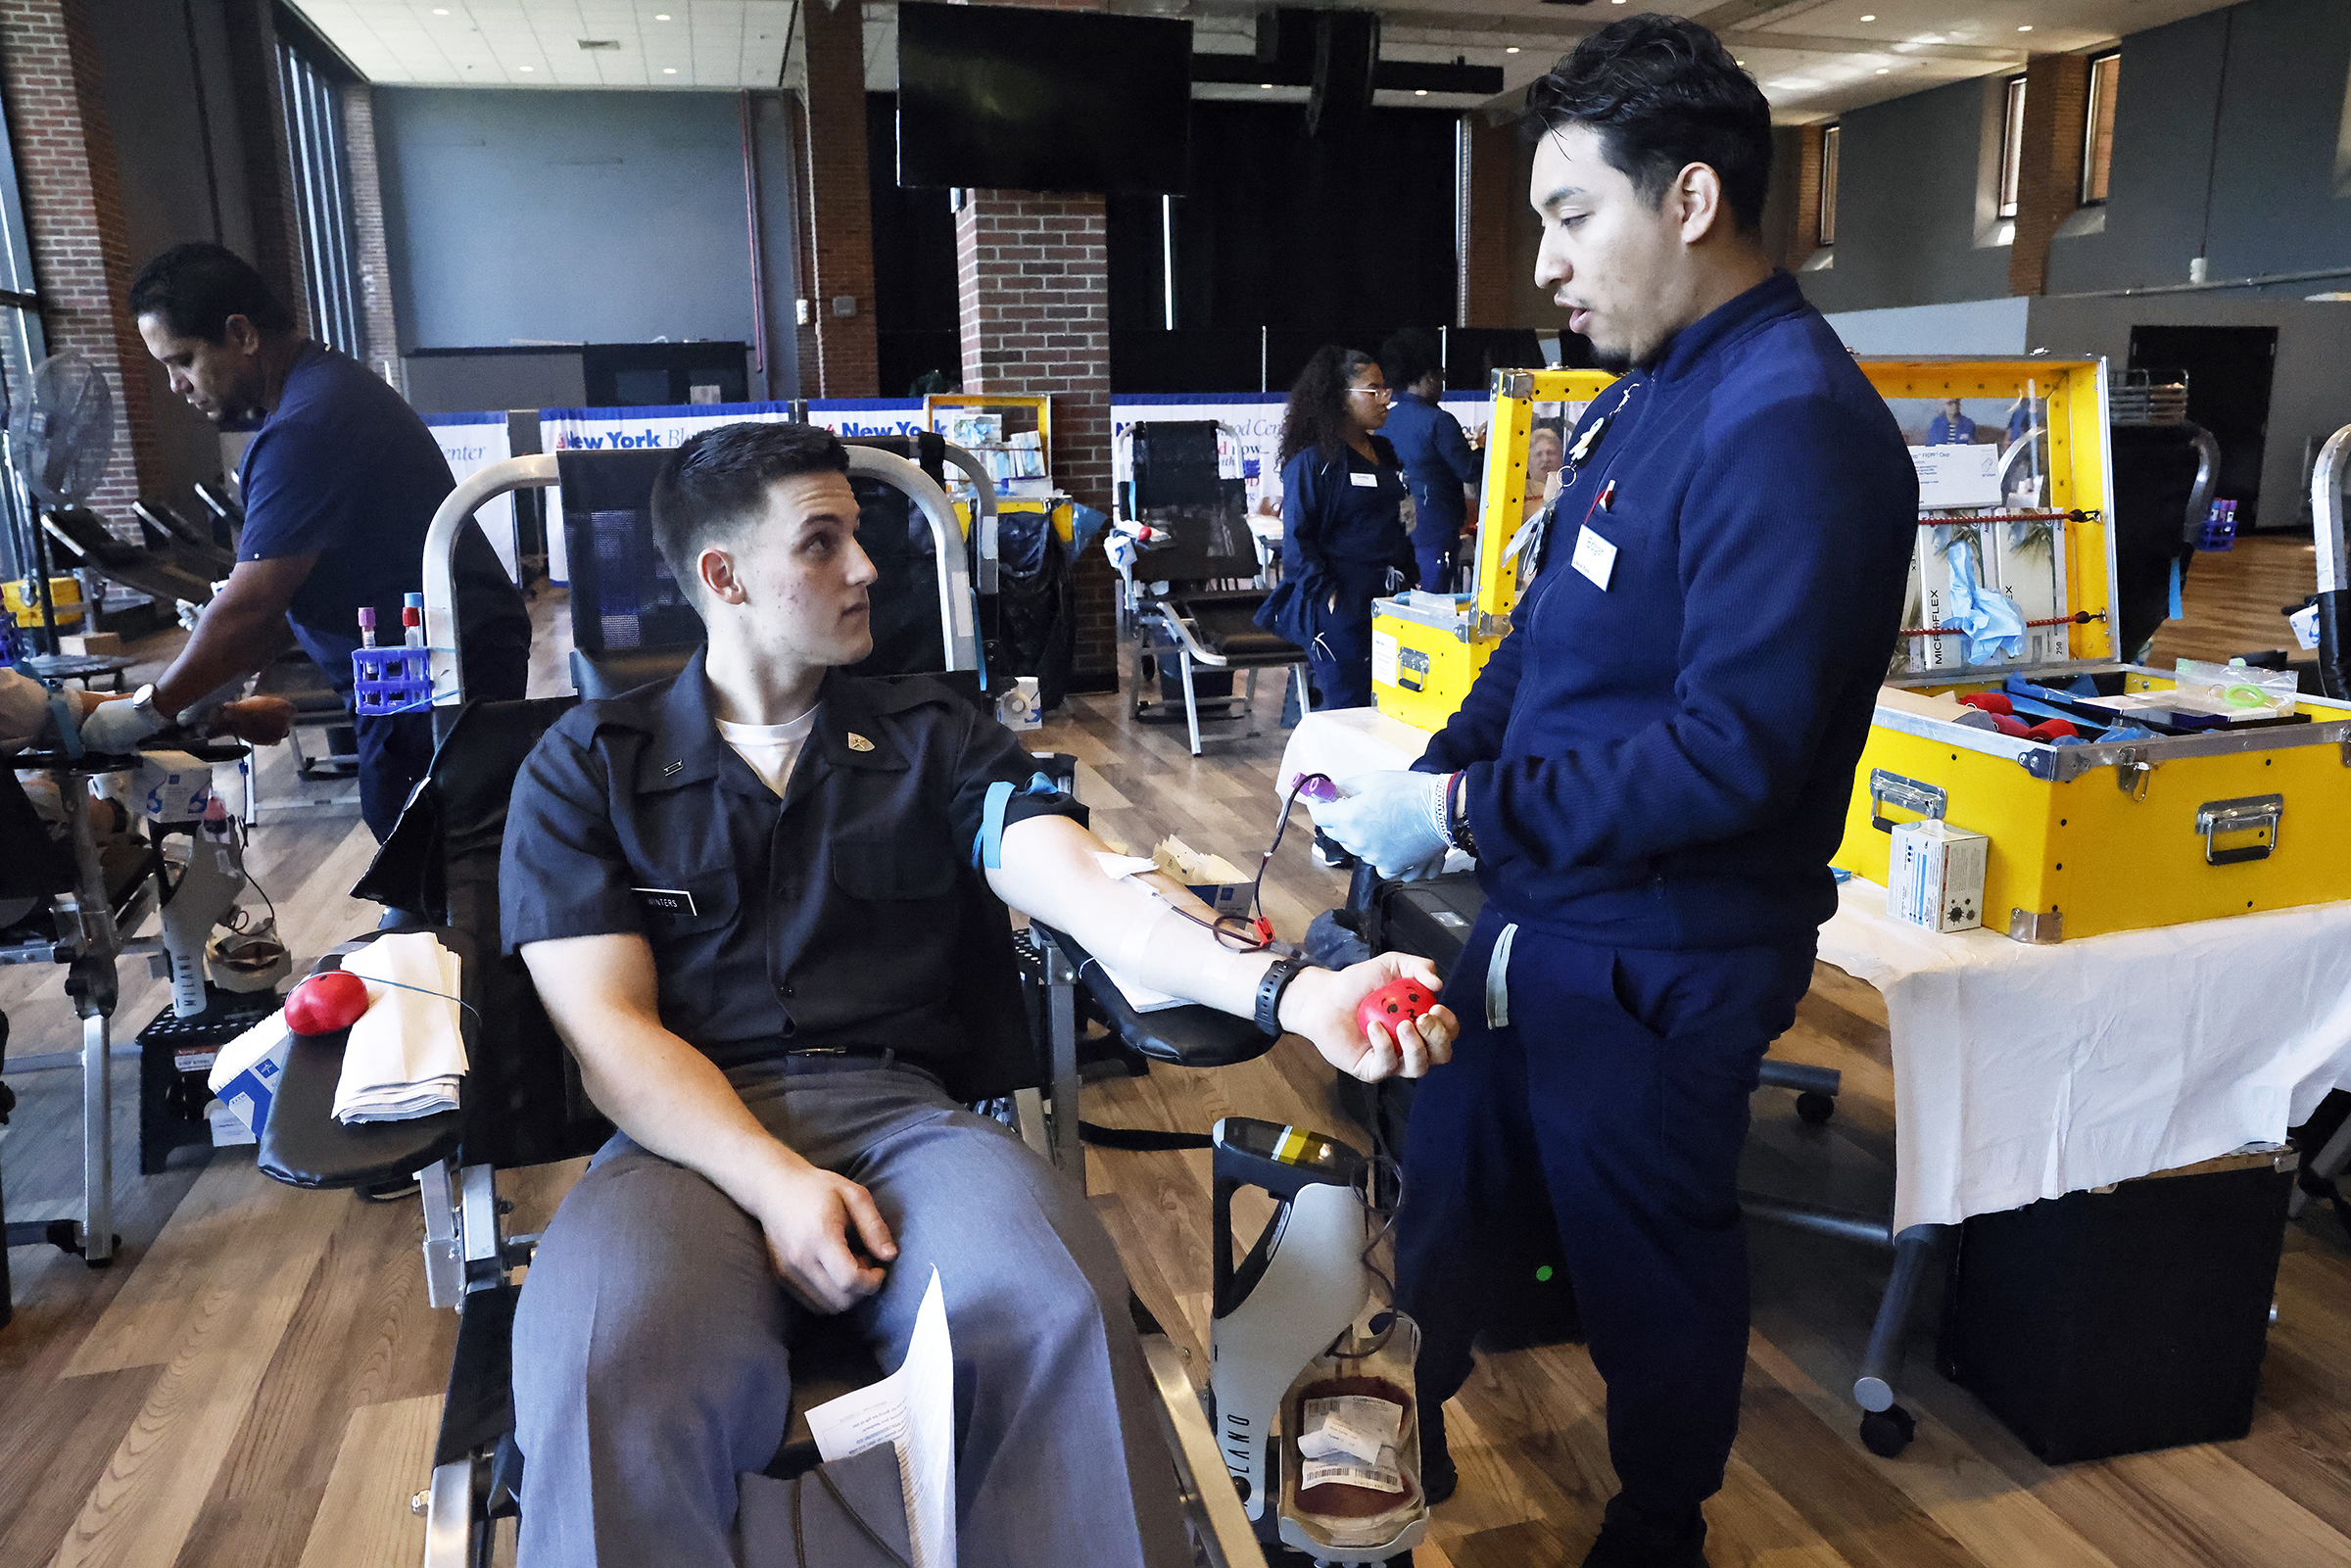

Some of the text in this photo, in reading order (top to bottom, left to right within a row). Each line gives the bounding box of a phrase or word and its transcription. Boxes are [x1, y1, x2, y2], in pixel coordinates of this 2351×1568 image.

[841, 419, 948, 438] New Yok
[605, 429, 661, 449] York
[440, 444, 488, 461] enter
[648, 898, 678, 908] WINTERS
[177, 955, 197, 1006] MILANO
[1226, 1413, 1250, 1507] LANO
